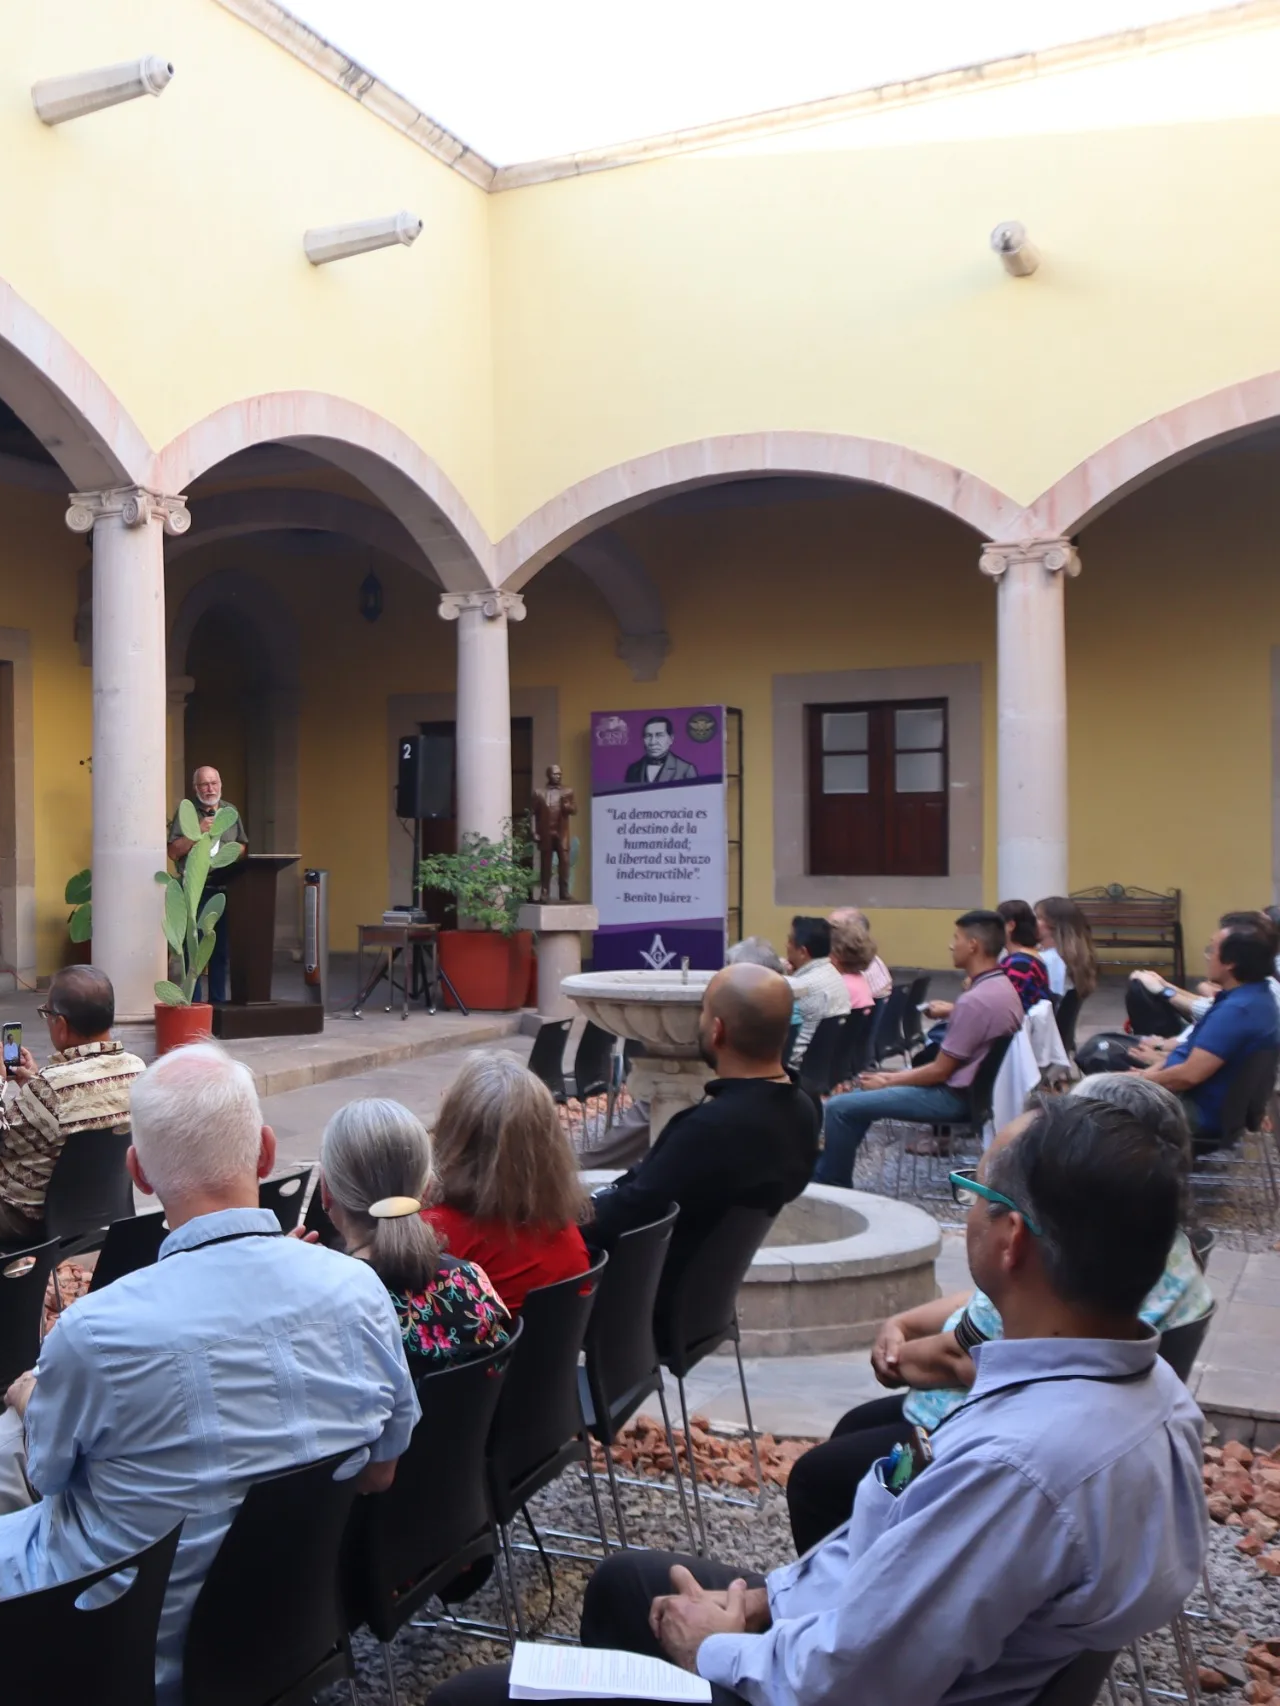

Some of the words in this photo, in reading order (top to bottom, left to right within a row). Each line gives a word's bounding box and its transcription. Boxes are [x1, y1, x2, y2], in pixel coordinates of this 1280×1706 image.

[403, 743, 412, 759] 2
[607, 808, 627, 820] “La
[628, 807, 693, 819] democracia
[695, 809, 708, 819] es
[617, 823, 627, 835] el
[628, 823, 669, 835] destino
[671, 822, 685, 834] de
[686, 822, 698, 834] la
[623, 837, 692, 851] humanidad;
[606, 853, 616, 865] la
[618, 852, 662, 865] libertad
[664, 856, 676, 865] su
[678, 852, 711, 865] brazo
[623, 892, 658, 903] Benito
[658, 891, 692, 904] Juárez
[653, 951, 663, 962] G
